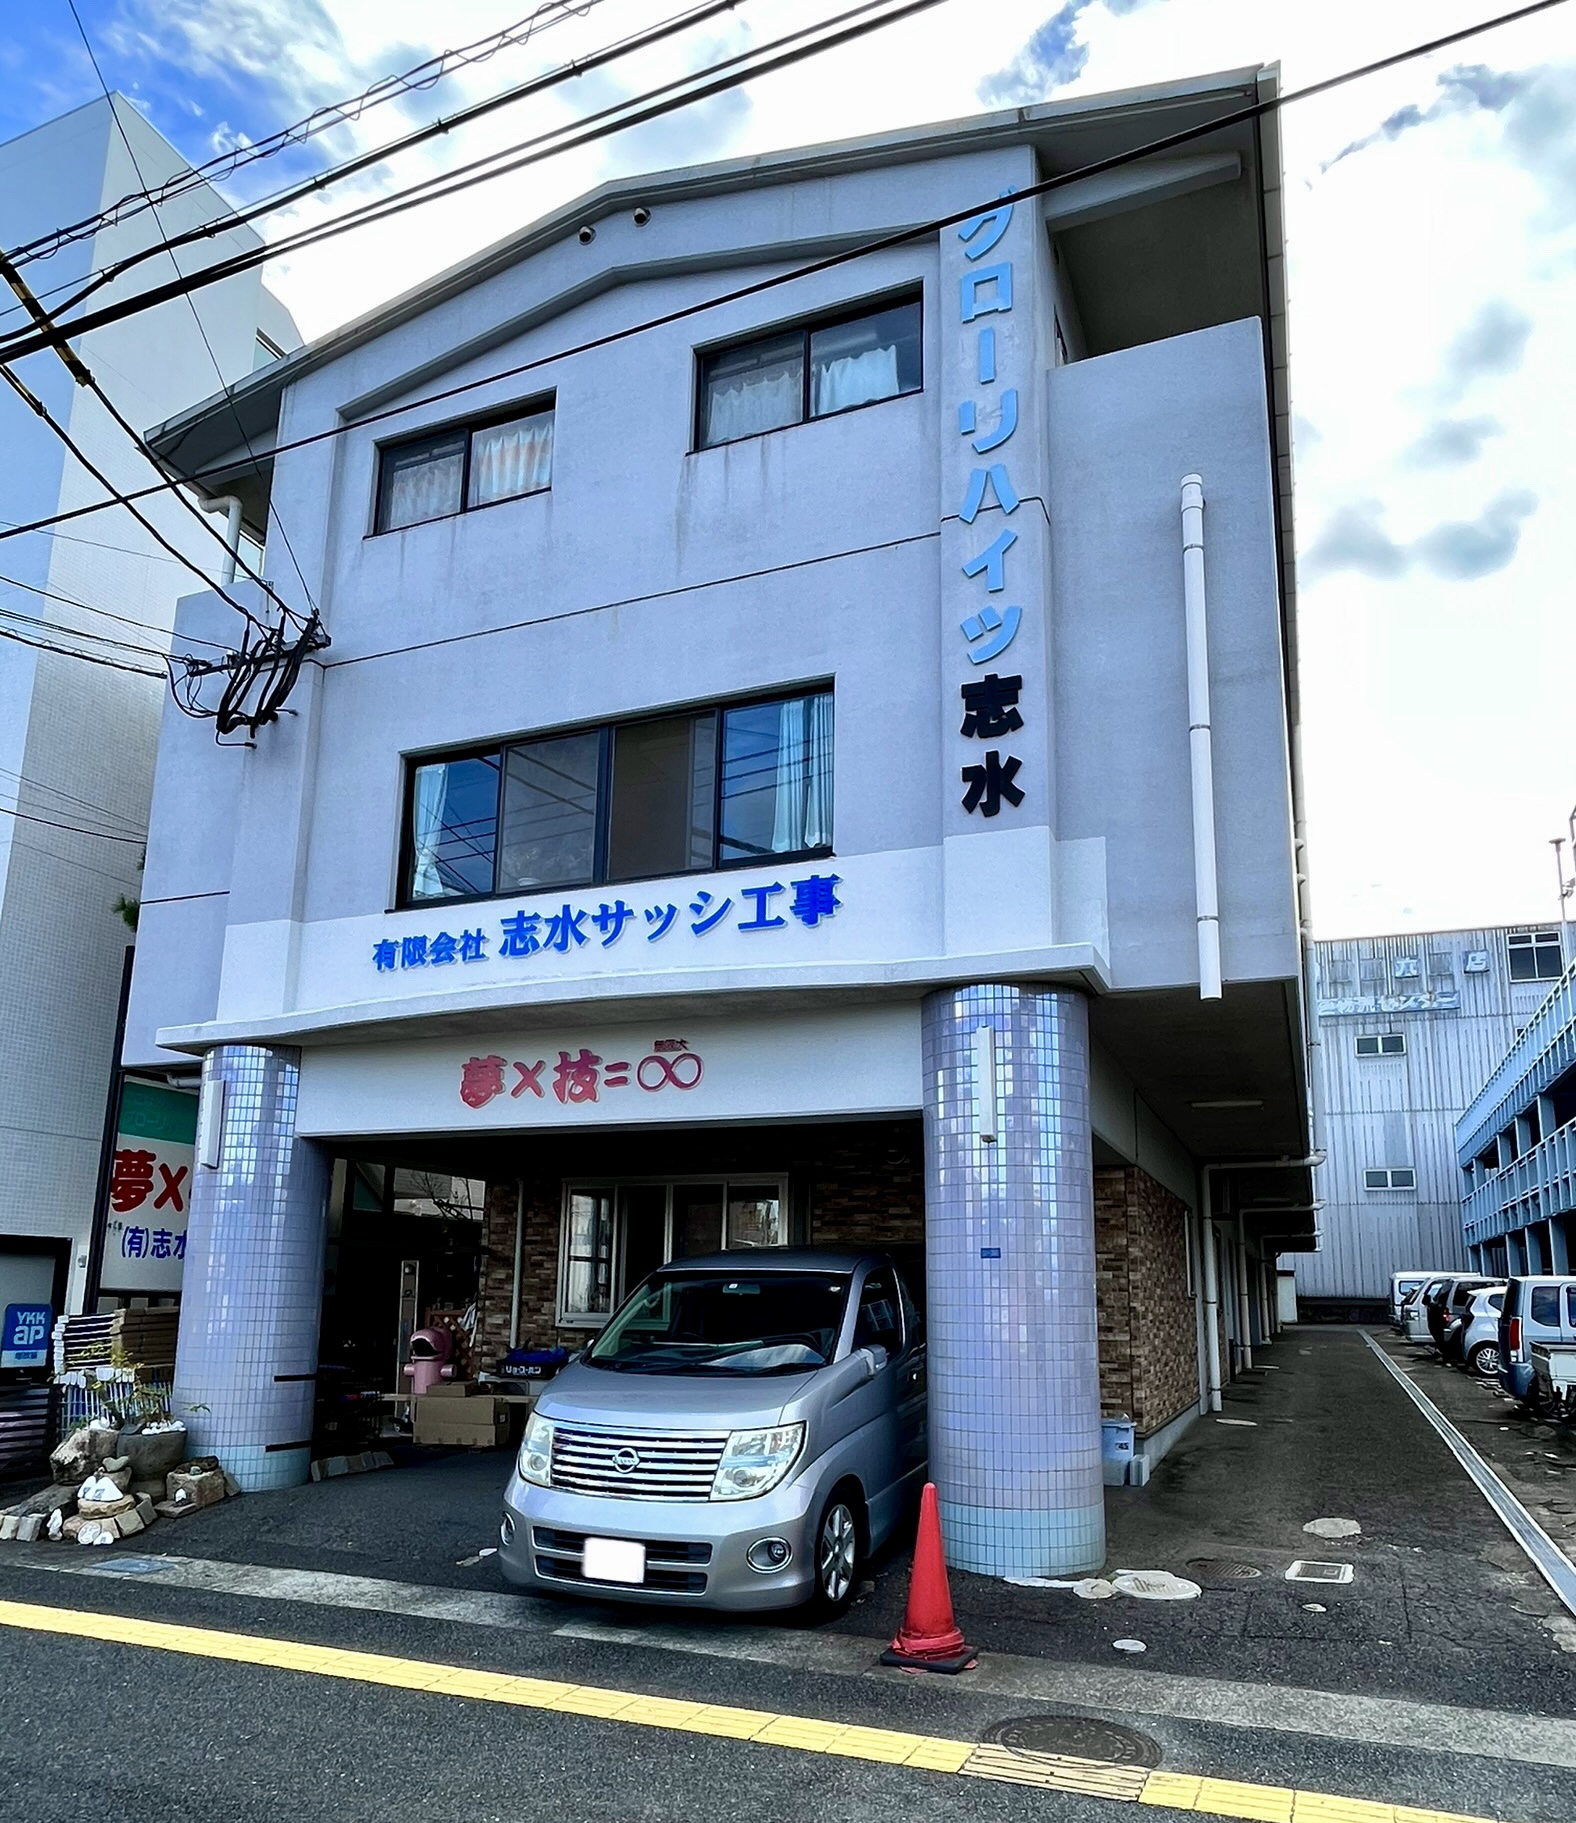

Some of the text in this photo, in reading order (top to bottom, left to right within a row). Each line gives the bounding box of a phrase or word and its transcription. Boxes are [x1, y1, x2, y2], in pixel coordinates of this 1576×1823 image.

[372, 873, 844, 972] 有限会社 志水サッシ工事
[16, 1311, 46, 1325] YKK
